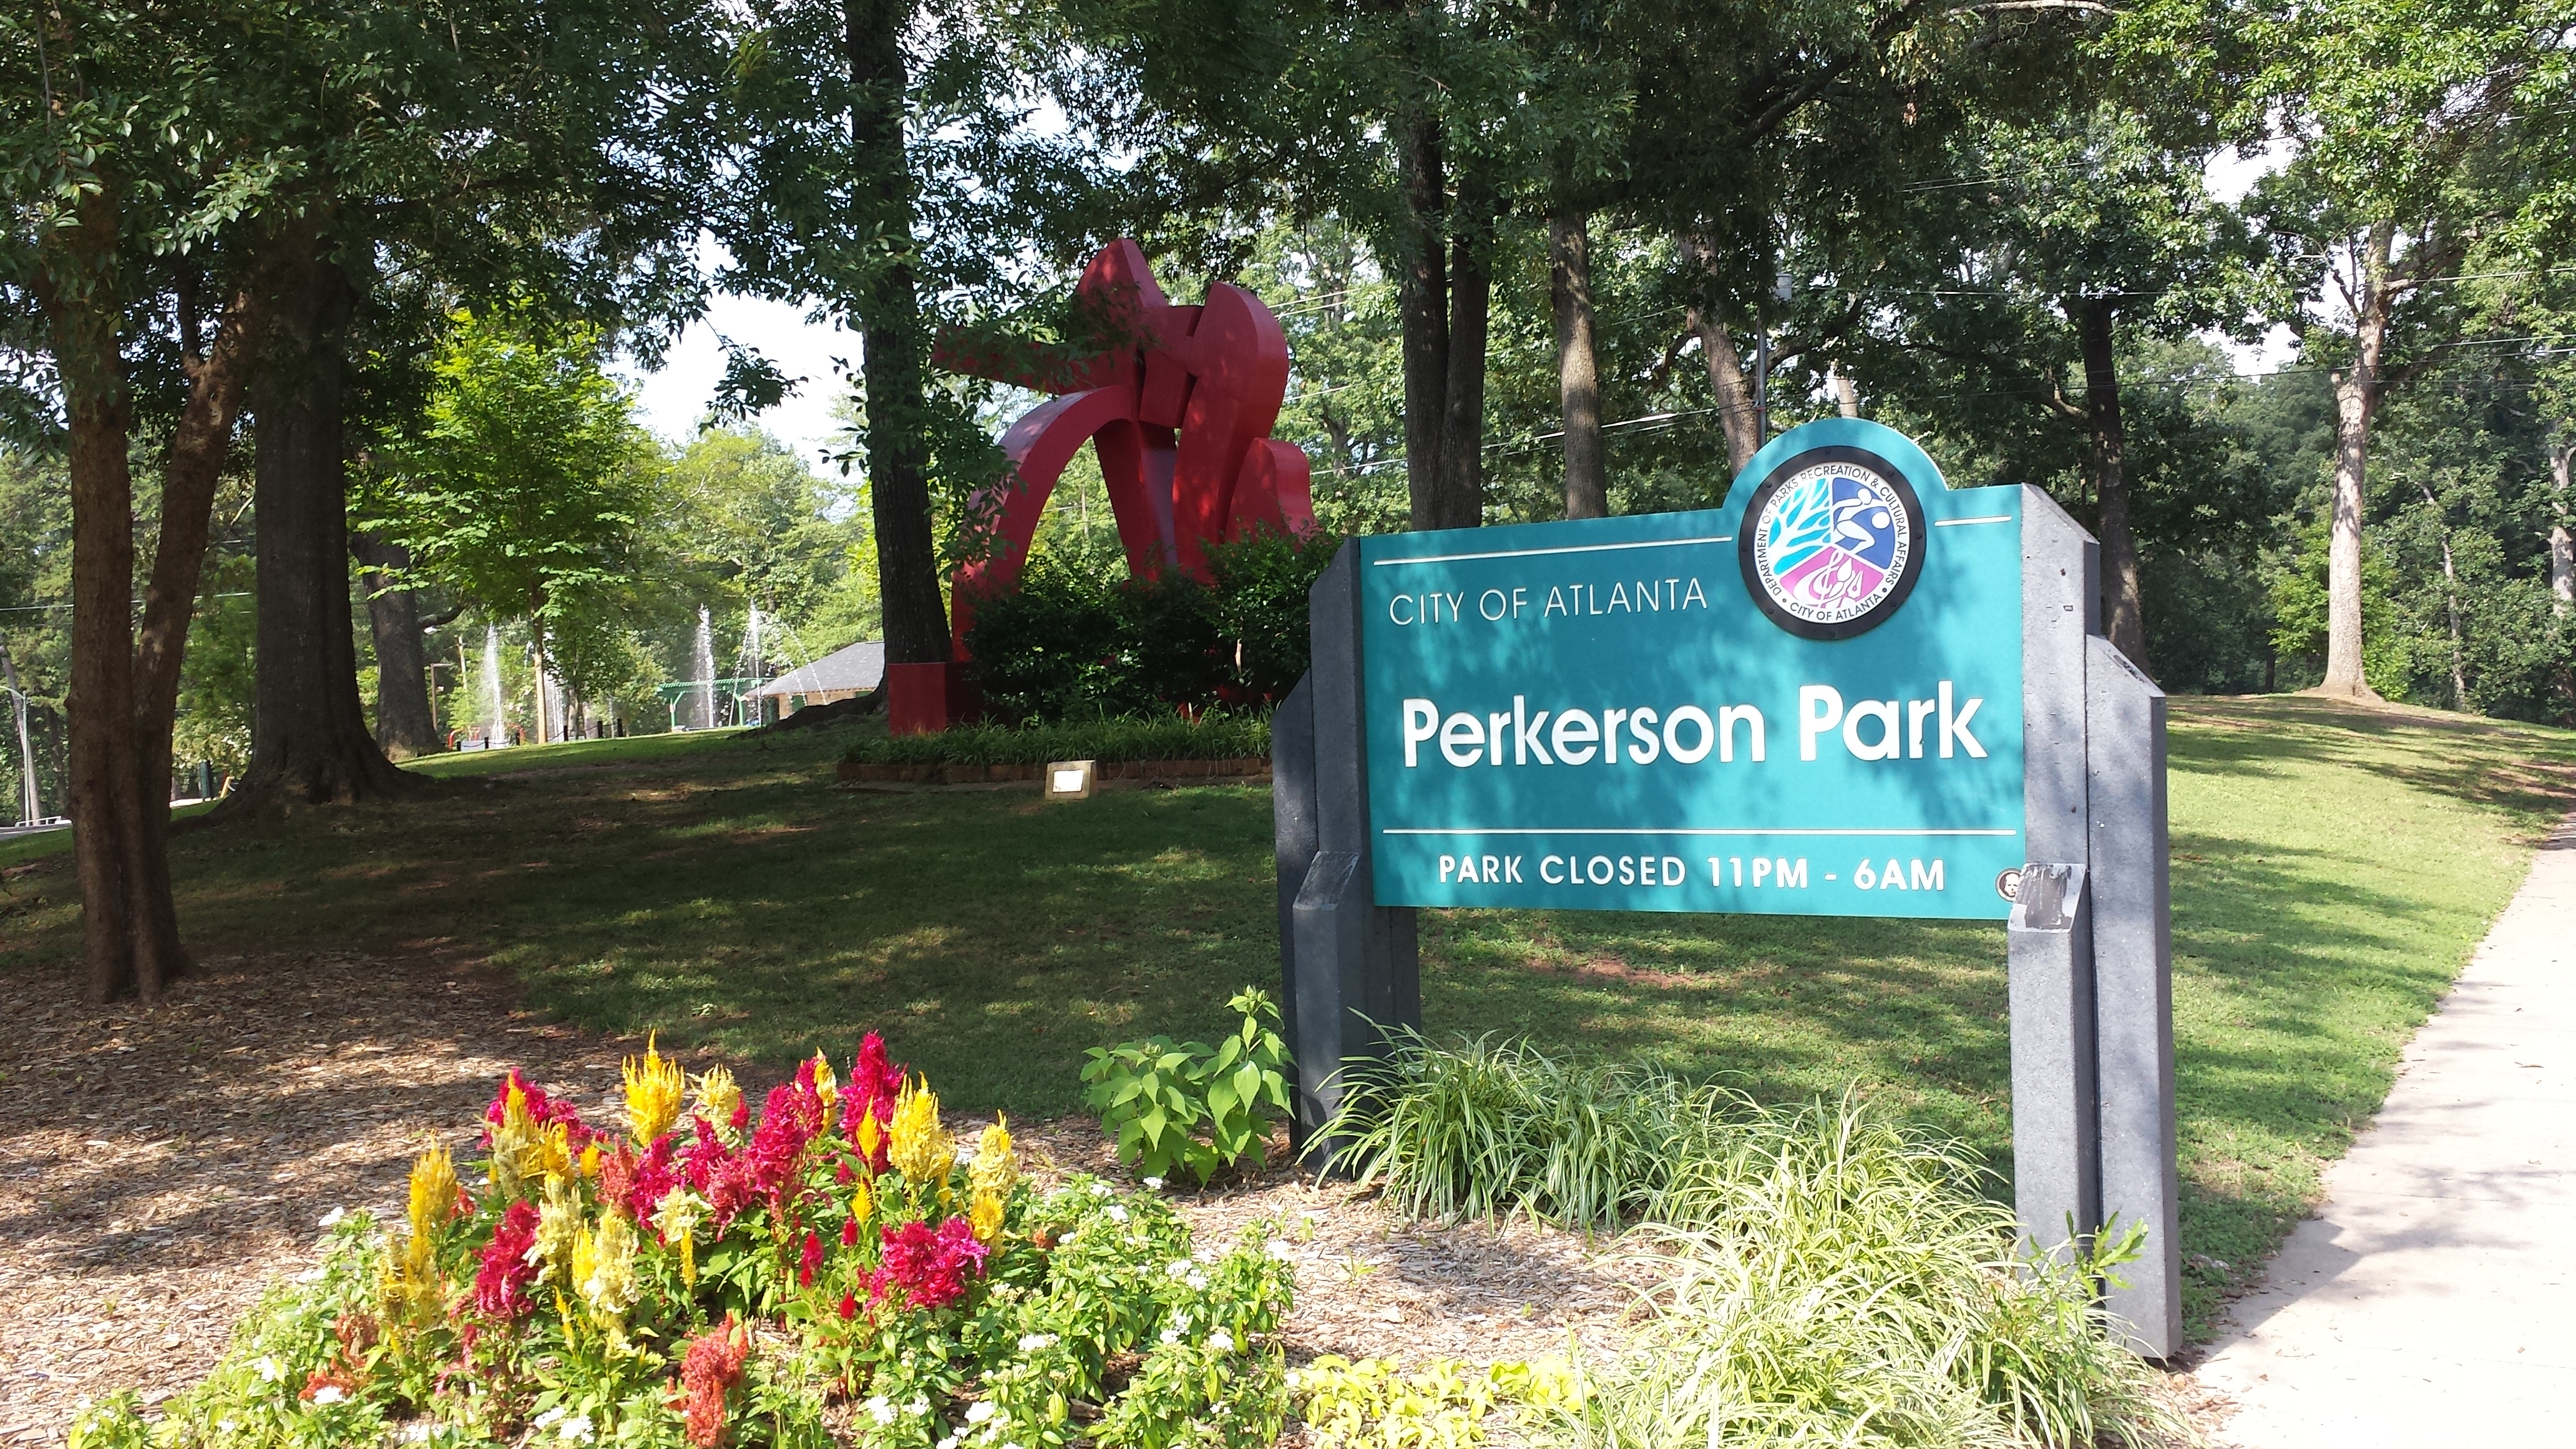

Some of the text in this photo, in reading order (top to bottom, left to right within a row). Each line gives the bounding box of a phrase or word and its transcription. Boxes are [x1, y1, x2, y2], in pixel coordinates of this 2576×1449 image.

[1757, 464, 1907, 597] DEPARTMENT OF PARKS RECREATION & CULTURAL AFFAIRS
[1389, 577, 1708, 625] CITY OF ATLANTA
[1790, 593, 1883, 621] CITY OF ATLANTA
[1402, 680, 1988, 768] Perkerson Park
[1438, 854, 1945, 891] PARK CLOSED 11PM - 6AM
